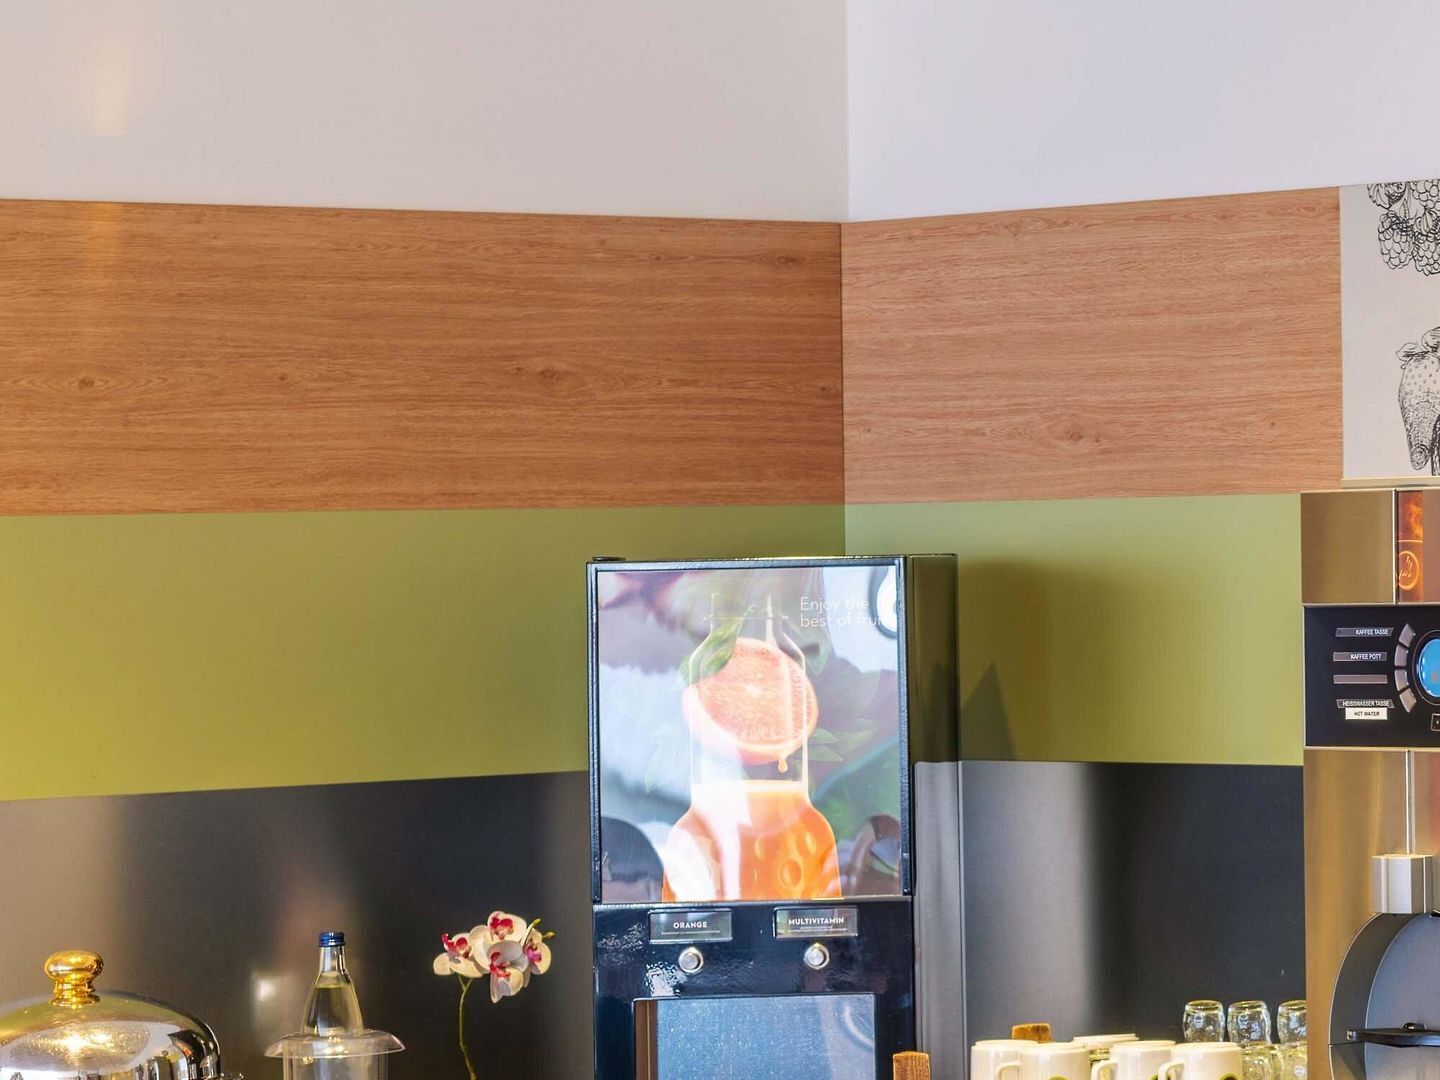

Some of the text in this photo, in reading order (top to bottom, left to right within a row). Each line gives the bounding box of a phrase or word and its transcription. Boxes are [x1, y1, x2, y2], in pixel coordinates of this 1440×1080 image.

[800, 596, 870, 614] Enjoy the
[800, 613, 831, 628] best
[837, 611, 853, 627] of
[1355, 628, 1389, 636] KAFFEE TASSE
[673, 921, 708, 930] ORANGE
[788, 916, 845, 926] MULTIVITAMIN
